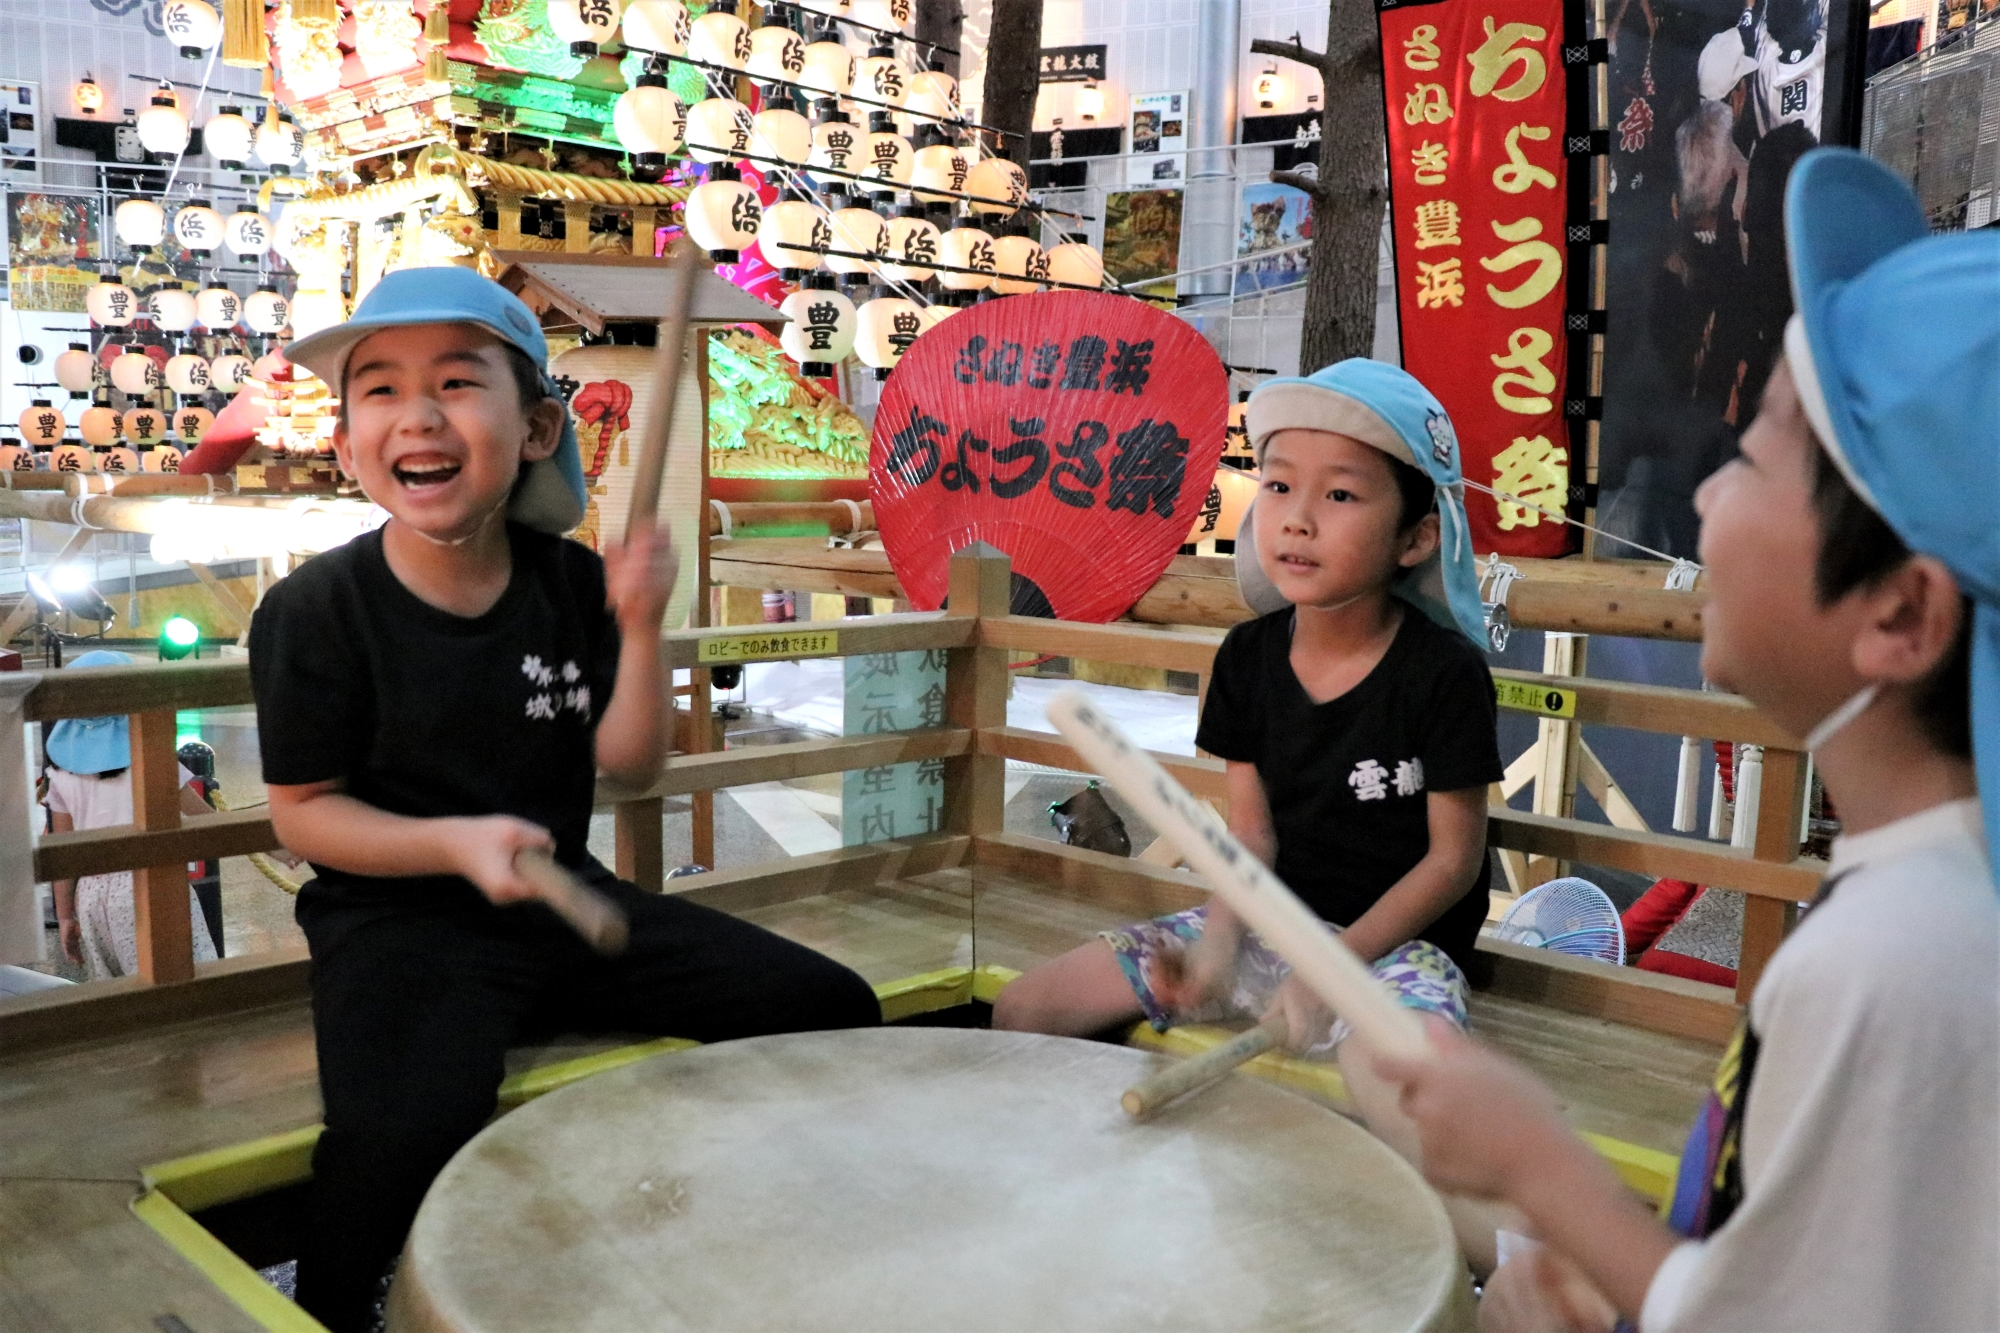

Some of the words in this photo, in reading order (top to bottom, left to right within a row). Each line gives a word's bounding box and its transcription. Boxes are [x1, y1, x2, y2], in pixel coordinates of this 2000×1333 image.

[167, 3, 193, 34] 浜
[579, 0, 613, 27] 浜
[782, 37, 806, 73] 浜
[874, 63, 903, 98] 浜
[823, 130, 853, 169] 豊
[870, 140, 899, 179] 豊
[1403, 23, 1466, 309] さぬき豊浜
[947, 155, 969, 191] 豊
[181, 213, 206, 239] 浜
[732, 191, 762, 235] 浜
[240, 218, 265, 245] 浜
[904, 226, 937, 263] 浜
[969, 238, 996, 272] 浜
[1466, 15, 1569, 532] ちょうさ祭
[109, 290, 130, 318] 豊
[220, 295, 237, 321] 豊
[271, 300, 288, 326] 豊
[803, 301, 840, 350] 豊
[189, 361, 210, 386] 浜
[953, 335, 1155, 396] さぬき豊浜
[36, 413, 57, 439] 豊
[135, 414, 155, 439] 豊
[180, 413, 200, 438] 豊
[886, 405, 1191, 520] ちょうさ祭
[709, 636, 829, 656] ロビーでのみ飲食できます
